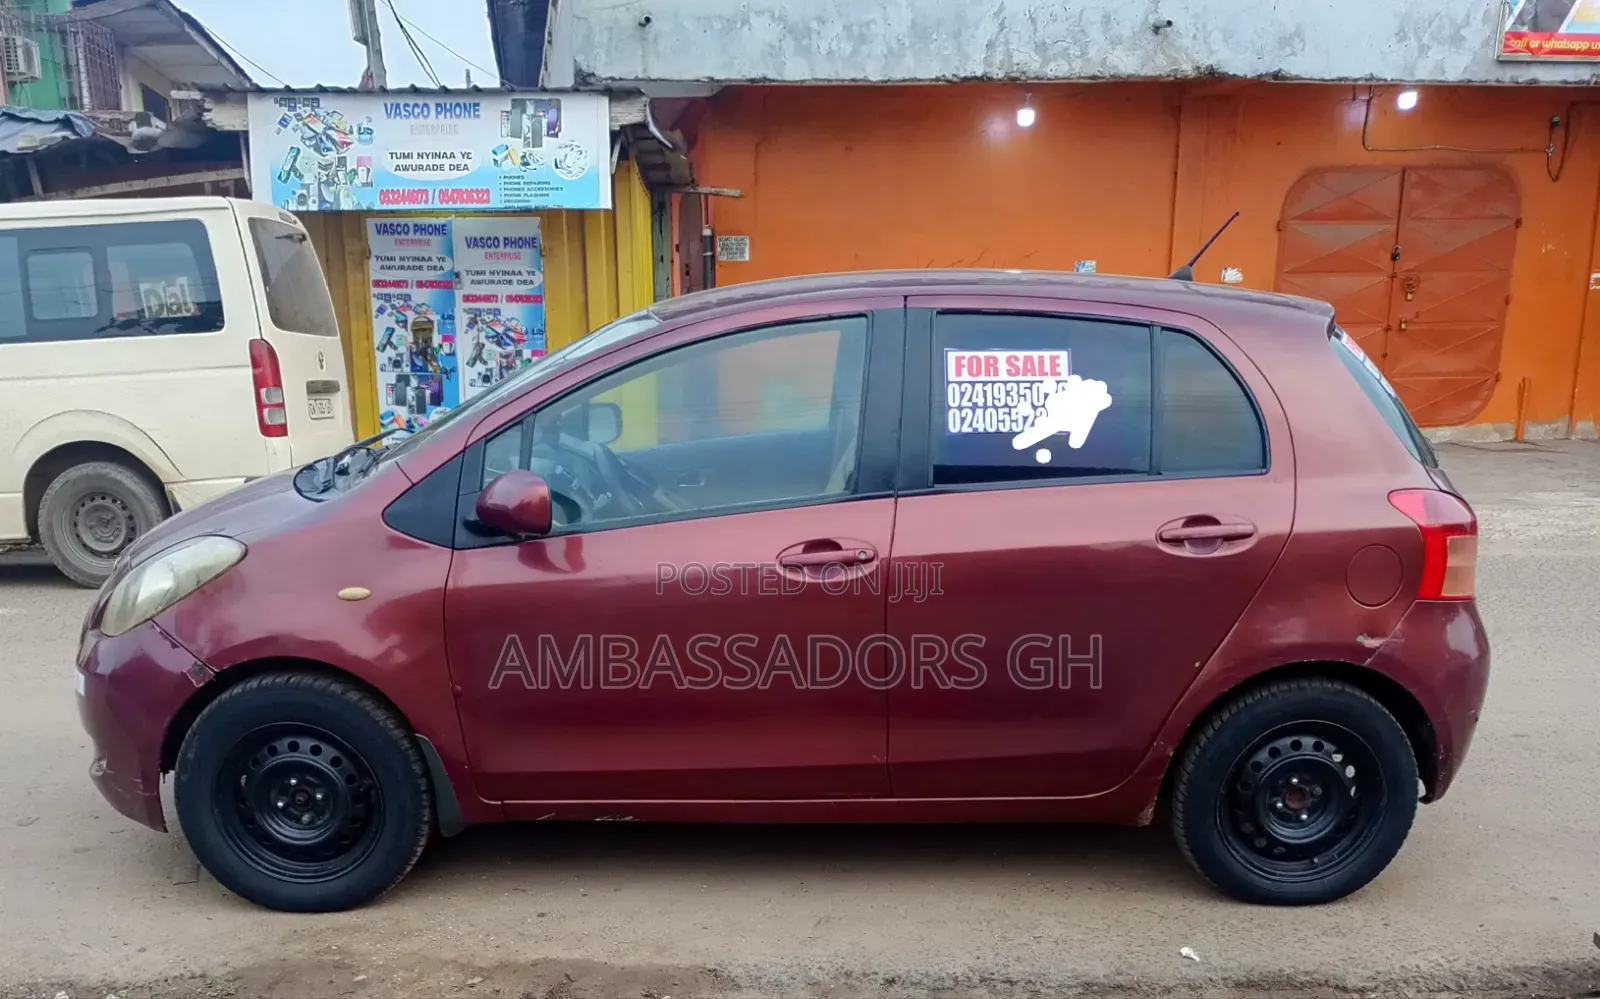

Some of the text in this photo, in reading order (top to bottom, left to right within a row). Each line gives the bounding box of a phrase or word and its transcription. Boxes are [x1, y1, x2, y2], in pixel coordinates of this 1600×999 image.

[1510, 37, 1528, 48] call
[1529, 40, 1540, 48] or
[1542, 37, 1589, 51] whatsapp
[383, 102, 480, 119] VASCO PHONE
[389, 151, 414, 160] TUMI
[417, 151, 456, 160] NYINAA
[394, 163, 470, 172] AWURADE DEA
[375, 223, 447, 236] VASCO PHONE
[465, 236, 537, 249] VASCO PHONE
[955, 355, 1061, 377] FOR SALE
